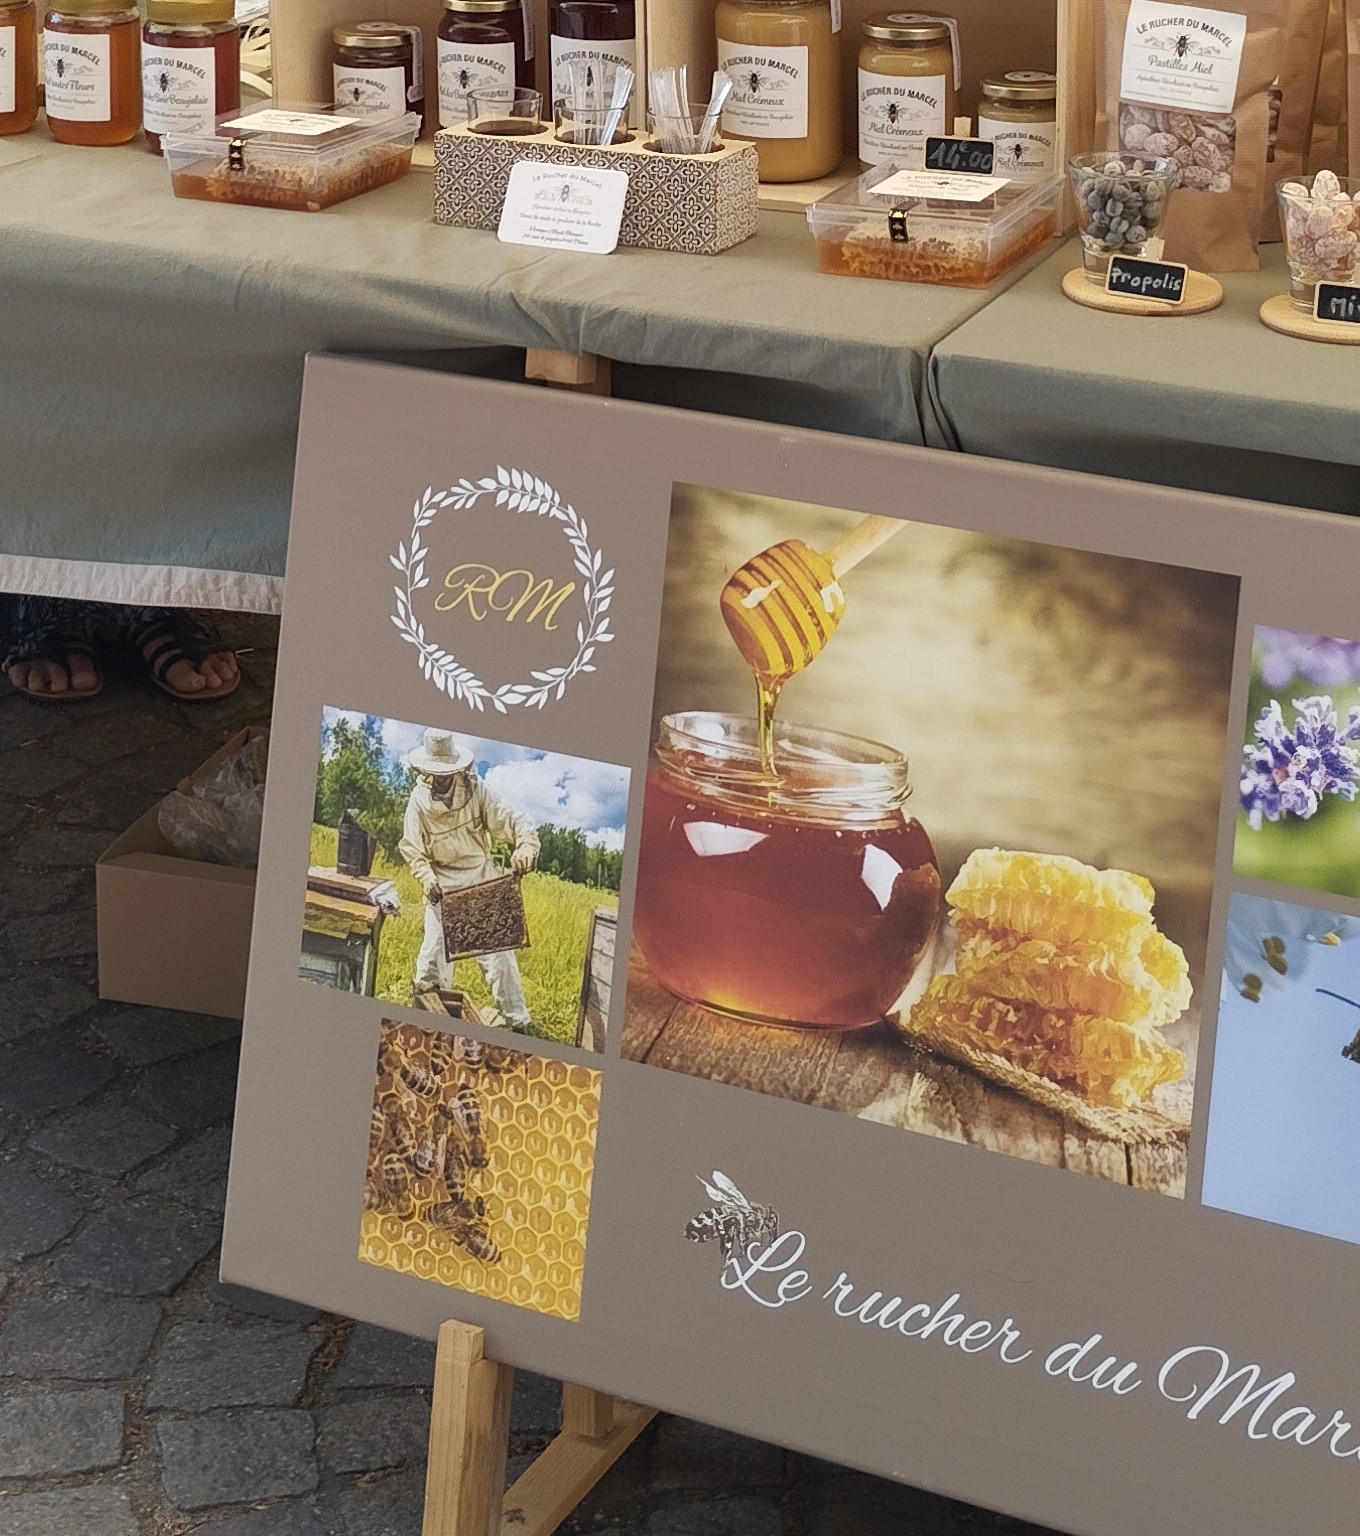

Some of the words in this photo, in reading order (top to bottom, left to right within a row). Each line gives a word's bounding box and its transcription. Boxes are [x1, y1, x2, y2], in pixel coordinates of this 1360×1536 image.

[1136, 24, 1148, 35] LE
[1149, 18, 1184, 30] RUCHER
[1187, 19, 1199, 28] DU
[1201, 23, 1232, 47] MARCEL
[176, 60, 206, 79] MARCEL
[768, 59, 799, 79] MARCEL
[1148, 55, 1188, 71] Pastilles
[1190, 62, 1213, 75] Miel
[894, 87, 905, 96] DU
[908, 89, 937, 109] MARCEL
[1111, 267, 1181, 293] Propolis
[434, 563, 576, 631] RM
[719, 1229, 813, 1308] Le
[822, 1272, 1033, 1365] rucher
[1044, 1333, 1142, 1397] du
